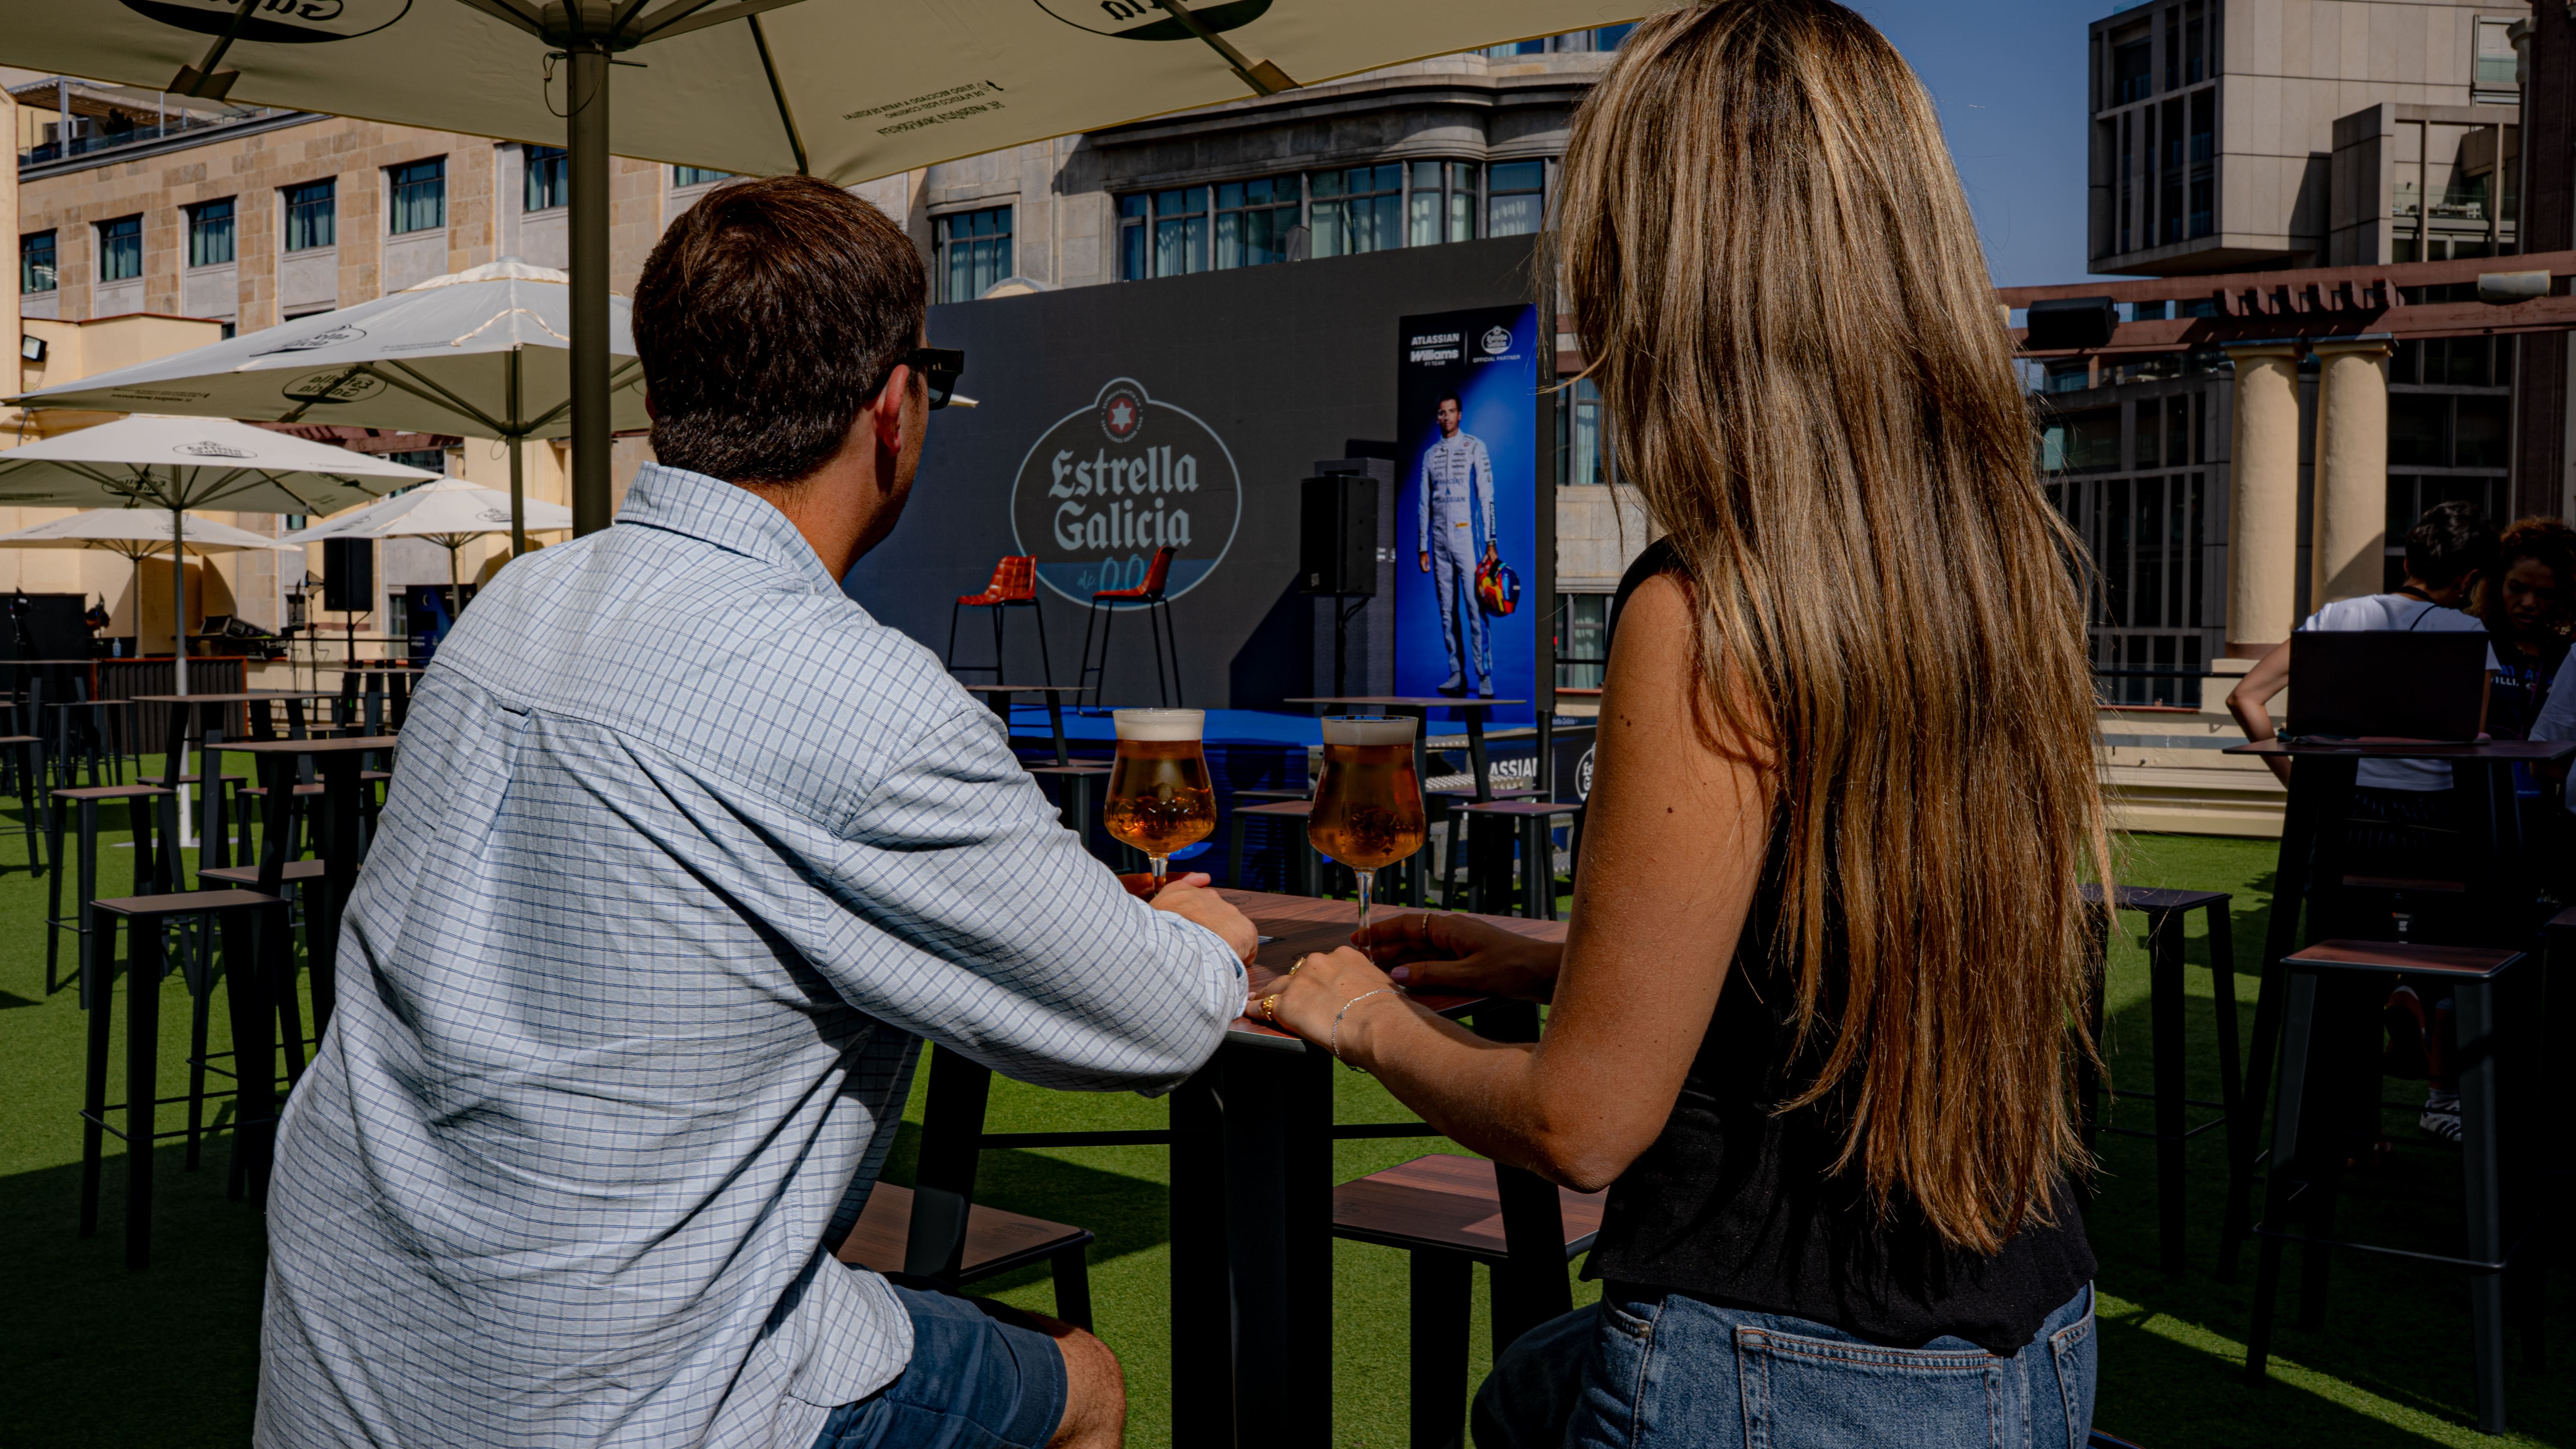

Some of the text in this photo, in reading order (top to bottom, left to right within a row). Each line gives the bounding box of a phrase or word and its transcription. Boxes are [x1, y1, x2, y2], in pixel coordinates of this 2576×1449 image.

[1410, 349, 1459, 362] Williams
[1411, 333, 1460, 346] ATLASSIAN
[1048, 445, 1199, 498] Estrella
[1054, 497, 1191, 550] Galicia
